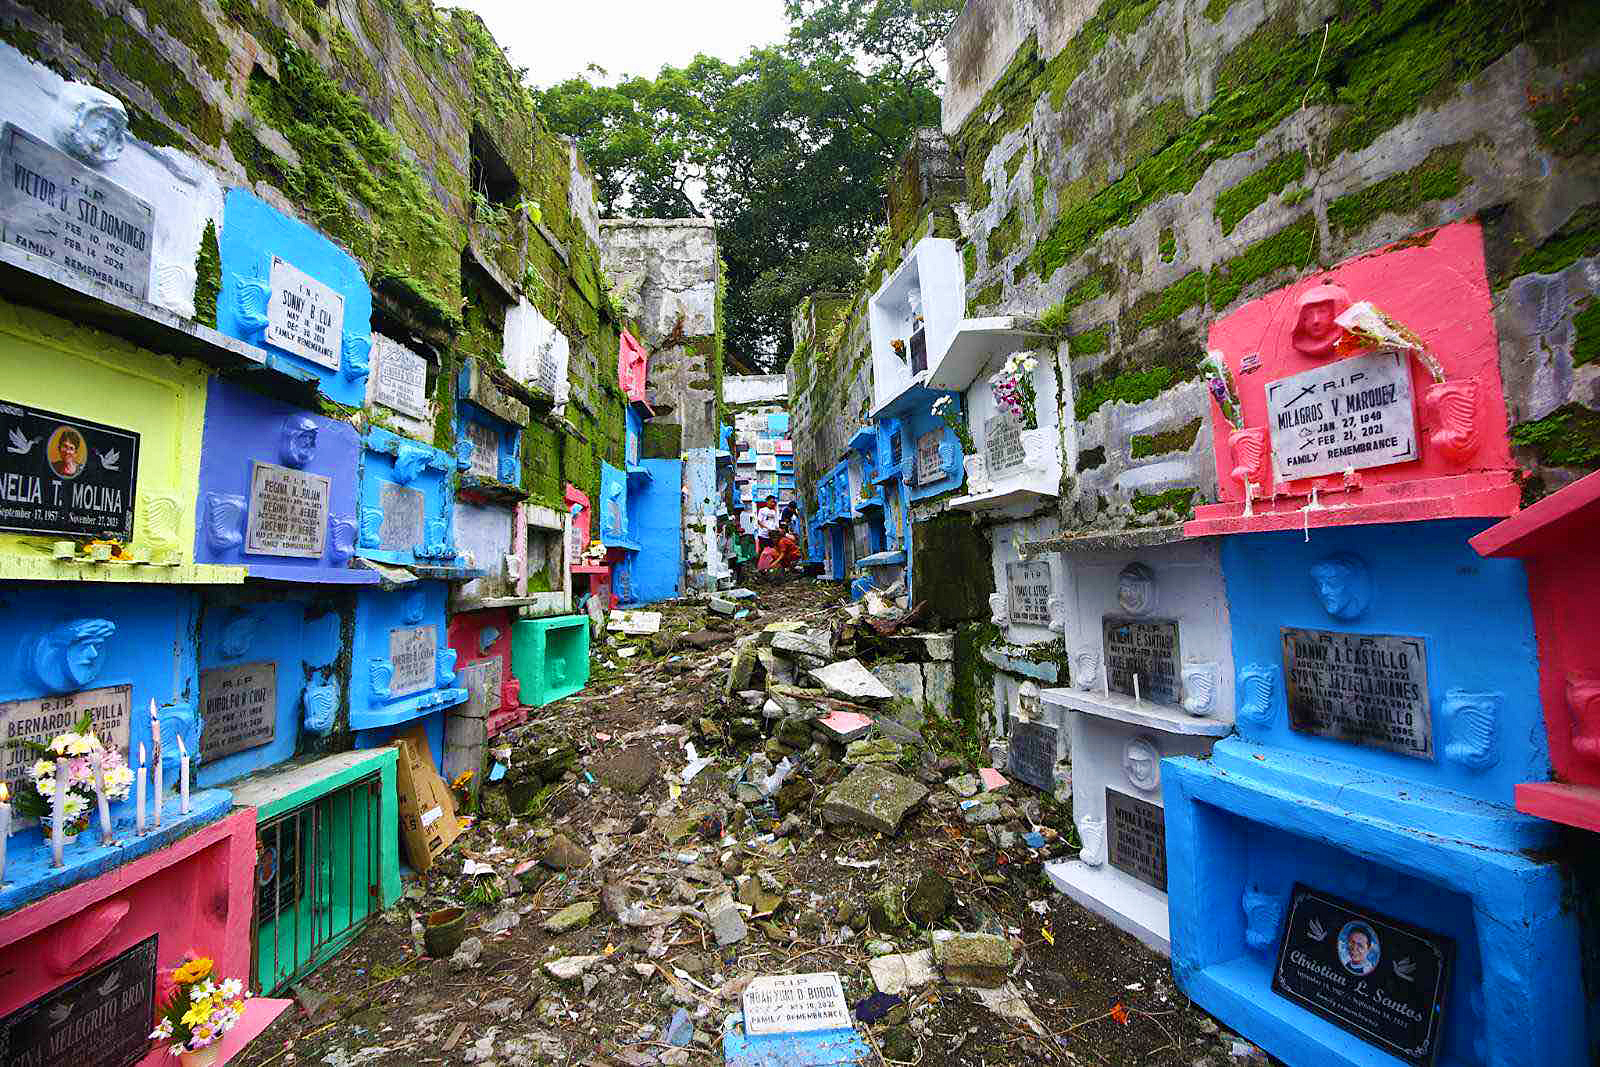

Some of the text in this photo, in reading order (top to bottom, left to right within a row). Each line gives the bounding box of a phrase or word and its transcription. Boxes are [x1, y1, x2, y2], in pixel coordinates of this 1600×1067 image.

[14, 162, 55, 207] VICTOR
[101, 209, 146, 251] DOMINGO
[15, 234, 134, 293] FAMILY REMEMBRANCE
[282, 289, 305, 314] SONNY
[275, 326, 334, 359] FAMILY REMEMBRANCE
[1278, 402, 1323, 430] MILAGROS
[1346, 383, 1398, 413] MARQUEZ
[1362, 423, 1384, 436] 2021
[1287, 436, 1399, 467] FAMILY REMEMBRANCE
[51, 479, 63, 507] T.
[72, 482, 123, 514] MOLINA
[1346, 648, 1408, 670] CASTILLO
[8, 713, 72, 738] BERNARDO
[1290, 950, 1348, 986] Christian
[1373, 988, 1424, 1022] Santos
[787, 1009, 843, 1021] REMEMBRANCE
